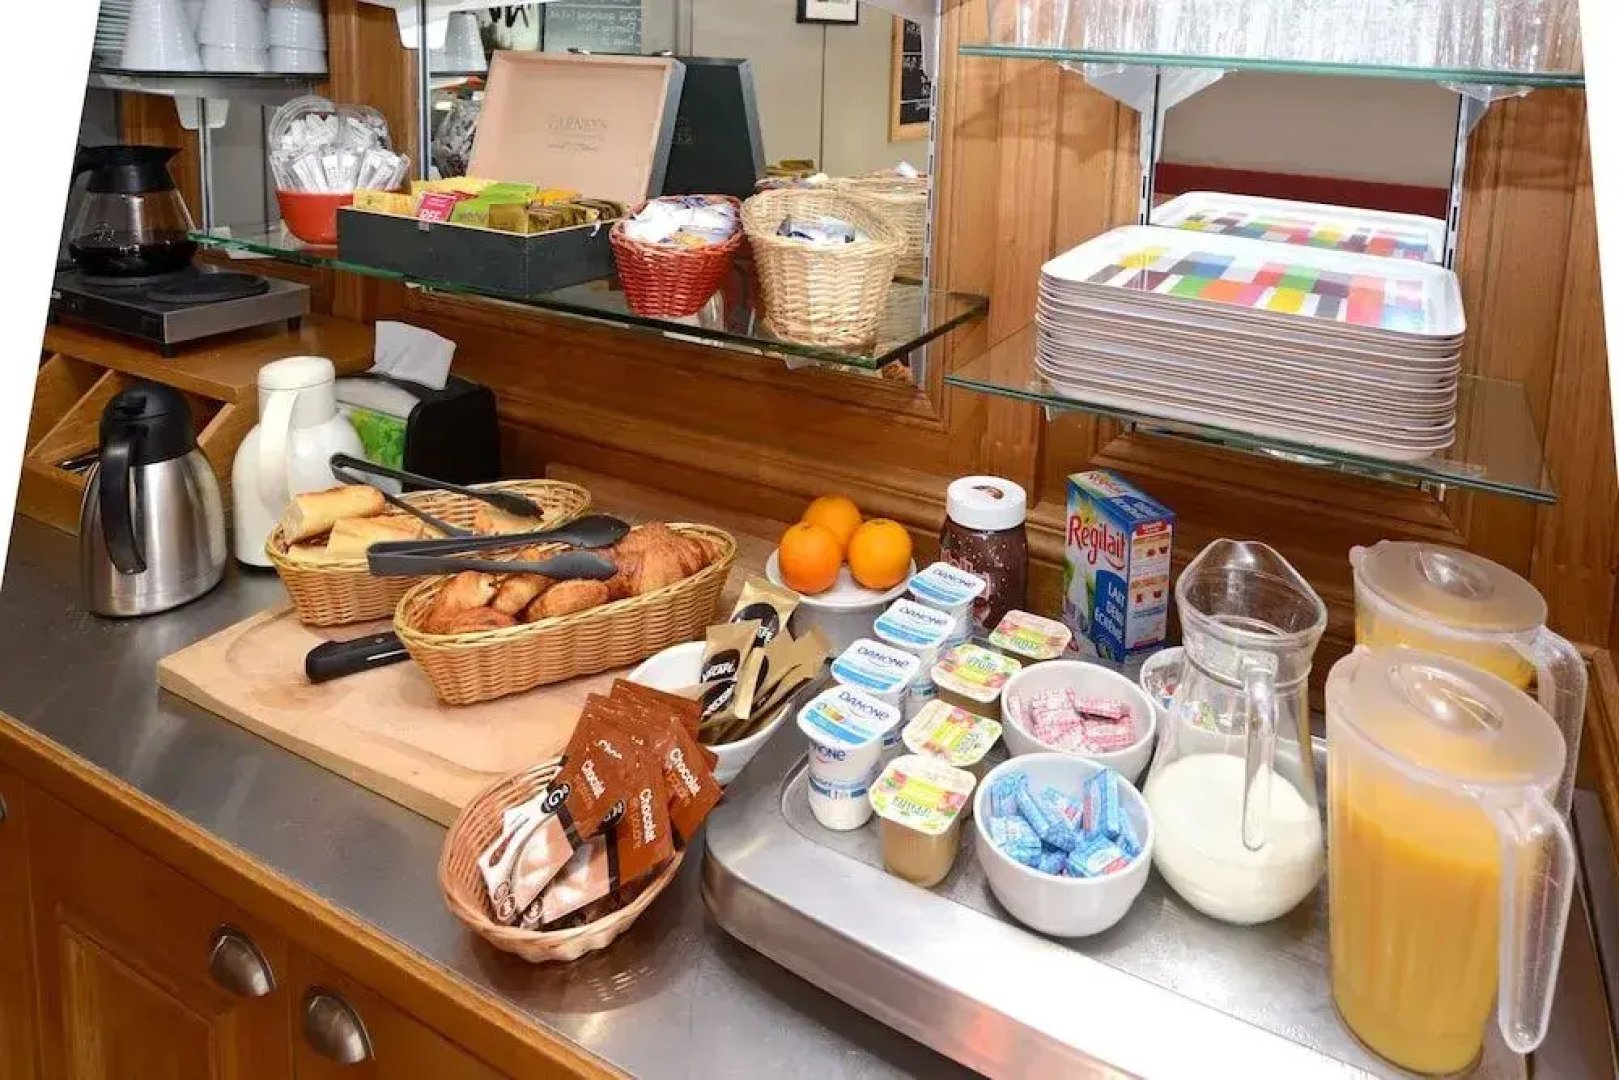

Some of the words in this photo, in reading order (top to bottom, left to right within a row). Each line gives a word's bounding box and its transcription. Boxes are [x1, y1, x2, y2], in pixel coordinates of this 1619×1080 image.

[1068, 515, 1126, 566] Régilait
[857, 646, 909, 668] DANONE
[838, 689, 890, 722] DANONE
[639, 788, 656, 845] Chocolat
